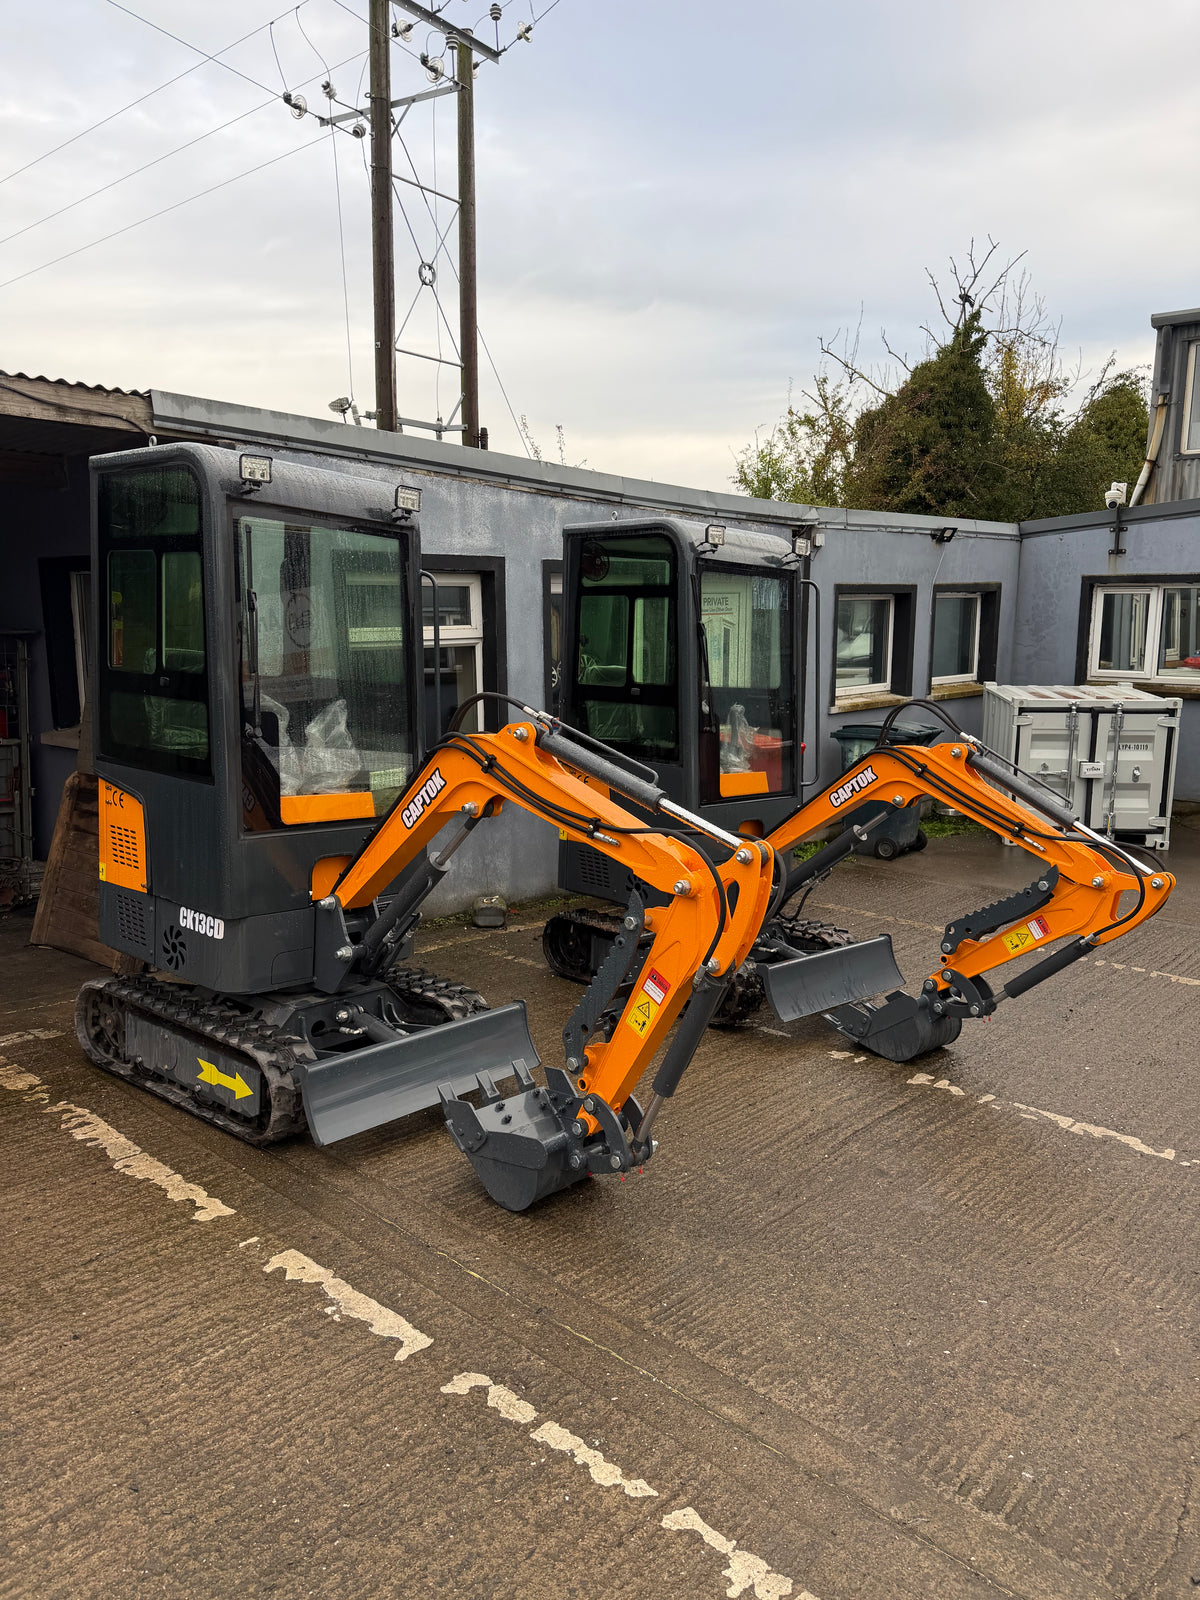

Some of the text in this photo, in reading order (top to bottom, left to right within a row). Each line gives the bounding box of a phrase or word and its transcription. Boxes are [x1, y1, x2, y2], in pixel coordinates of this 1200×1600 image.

[703, 597, 728, 606] PRIVATE
[401, 767, 447, 830] CAPTOK
[829, 764, 879, 808] CAPTOK
[179, 906, 225, 940] CK13CD
